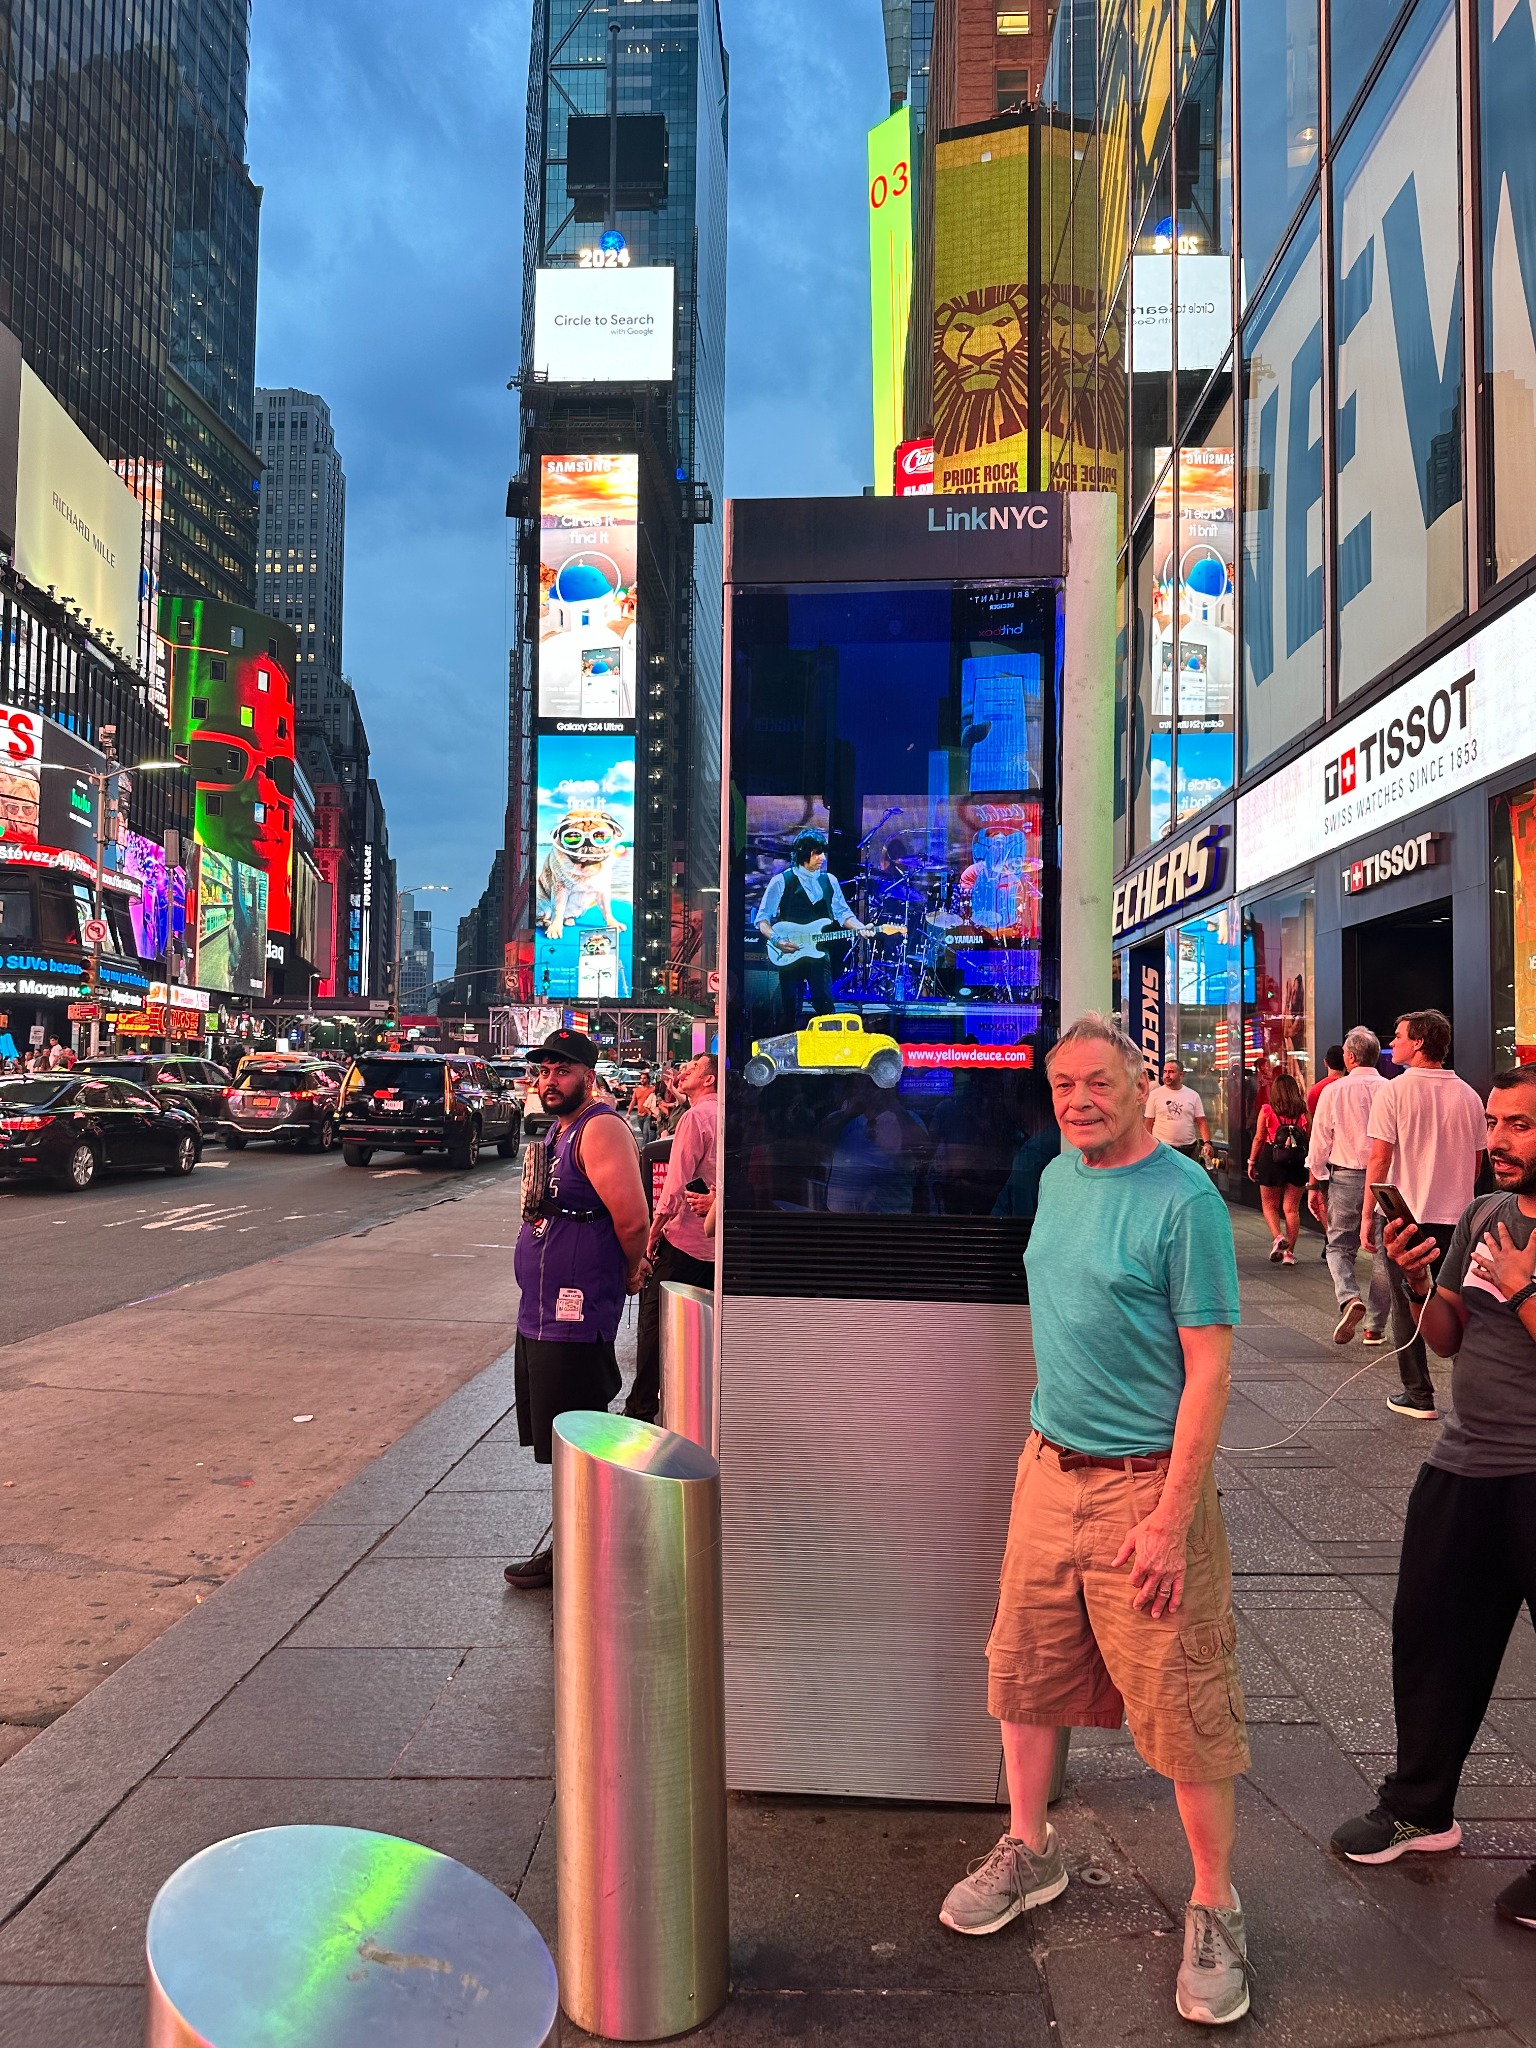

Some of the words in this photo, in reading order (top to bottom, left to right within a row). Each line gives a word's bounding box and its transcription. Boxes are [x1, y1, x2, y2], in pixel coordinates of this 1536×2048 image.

[870, 161, 909, 210] 03
[579, 249, 630, 268] 2024
[554, 315, 591, 326] Circle
[595, 315, 607, 326] to
[610, 314, 654, 326] Search
[627, 327, 654, 337] Google
[547, 461, 611, 473] SAMSUNG
[943, 465, 981, 489] PRIDE
[983, 461, 1019, 483] ROCK
[561, 515, 601, 527] Circle
[928, 505, 1049, 532] LinkNYC
[52, 491, 91, 543] RICHARD
[92, 537, 116, 568] MILLE
[569, 531, 597, 544] find
[599, 531, 609, 544] it
[557, 722, 587, 733] Galaxy
[588, 722, 603, 731] S24
[604, 722, 624, 731] Ultra
[1359, 669, 1476, 783] TISSOT
[558, 779, 600, 793] Circle
[1324, 807, 1353, 835] SWISS
[1357, 780, 1404, 818] WATCHES
[1409, 755, 1444, 793] SINCE
[1450, 738, 1478, 773] 1853
[72, 788, 91, 814] hulu
[567, 796, 595, 809] find
[597, 796, 607, 809] it
[1363, 832, 1433, 886] TISSOT
[363, 882, 372, 907] FOOT
[955, 936, 983, 944] YAMAHA
[6, 955, 48, 971] SUVs
[50, 959, 83, 974] becaus
[19, 980, 69, 999] Morgan
[908, 1049, 1026, 1063] www.yellowdeuce.com
